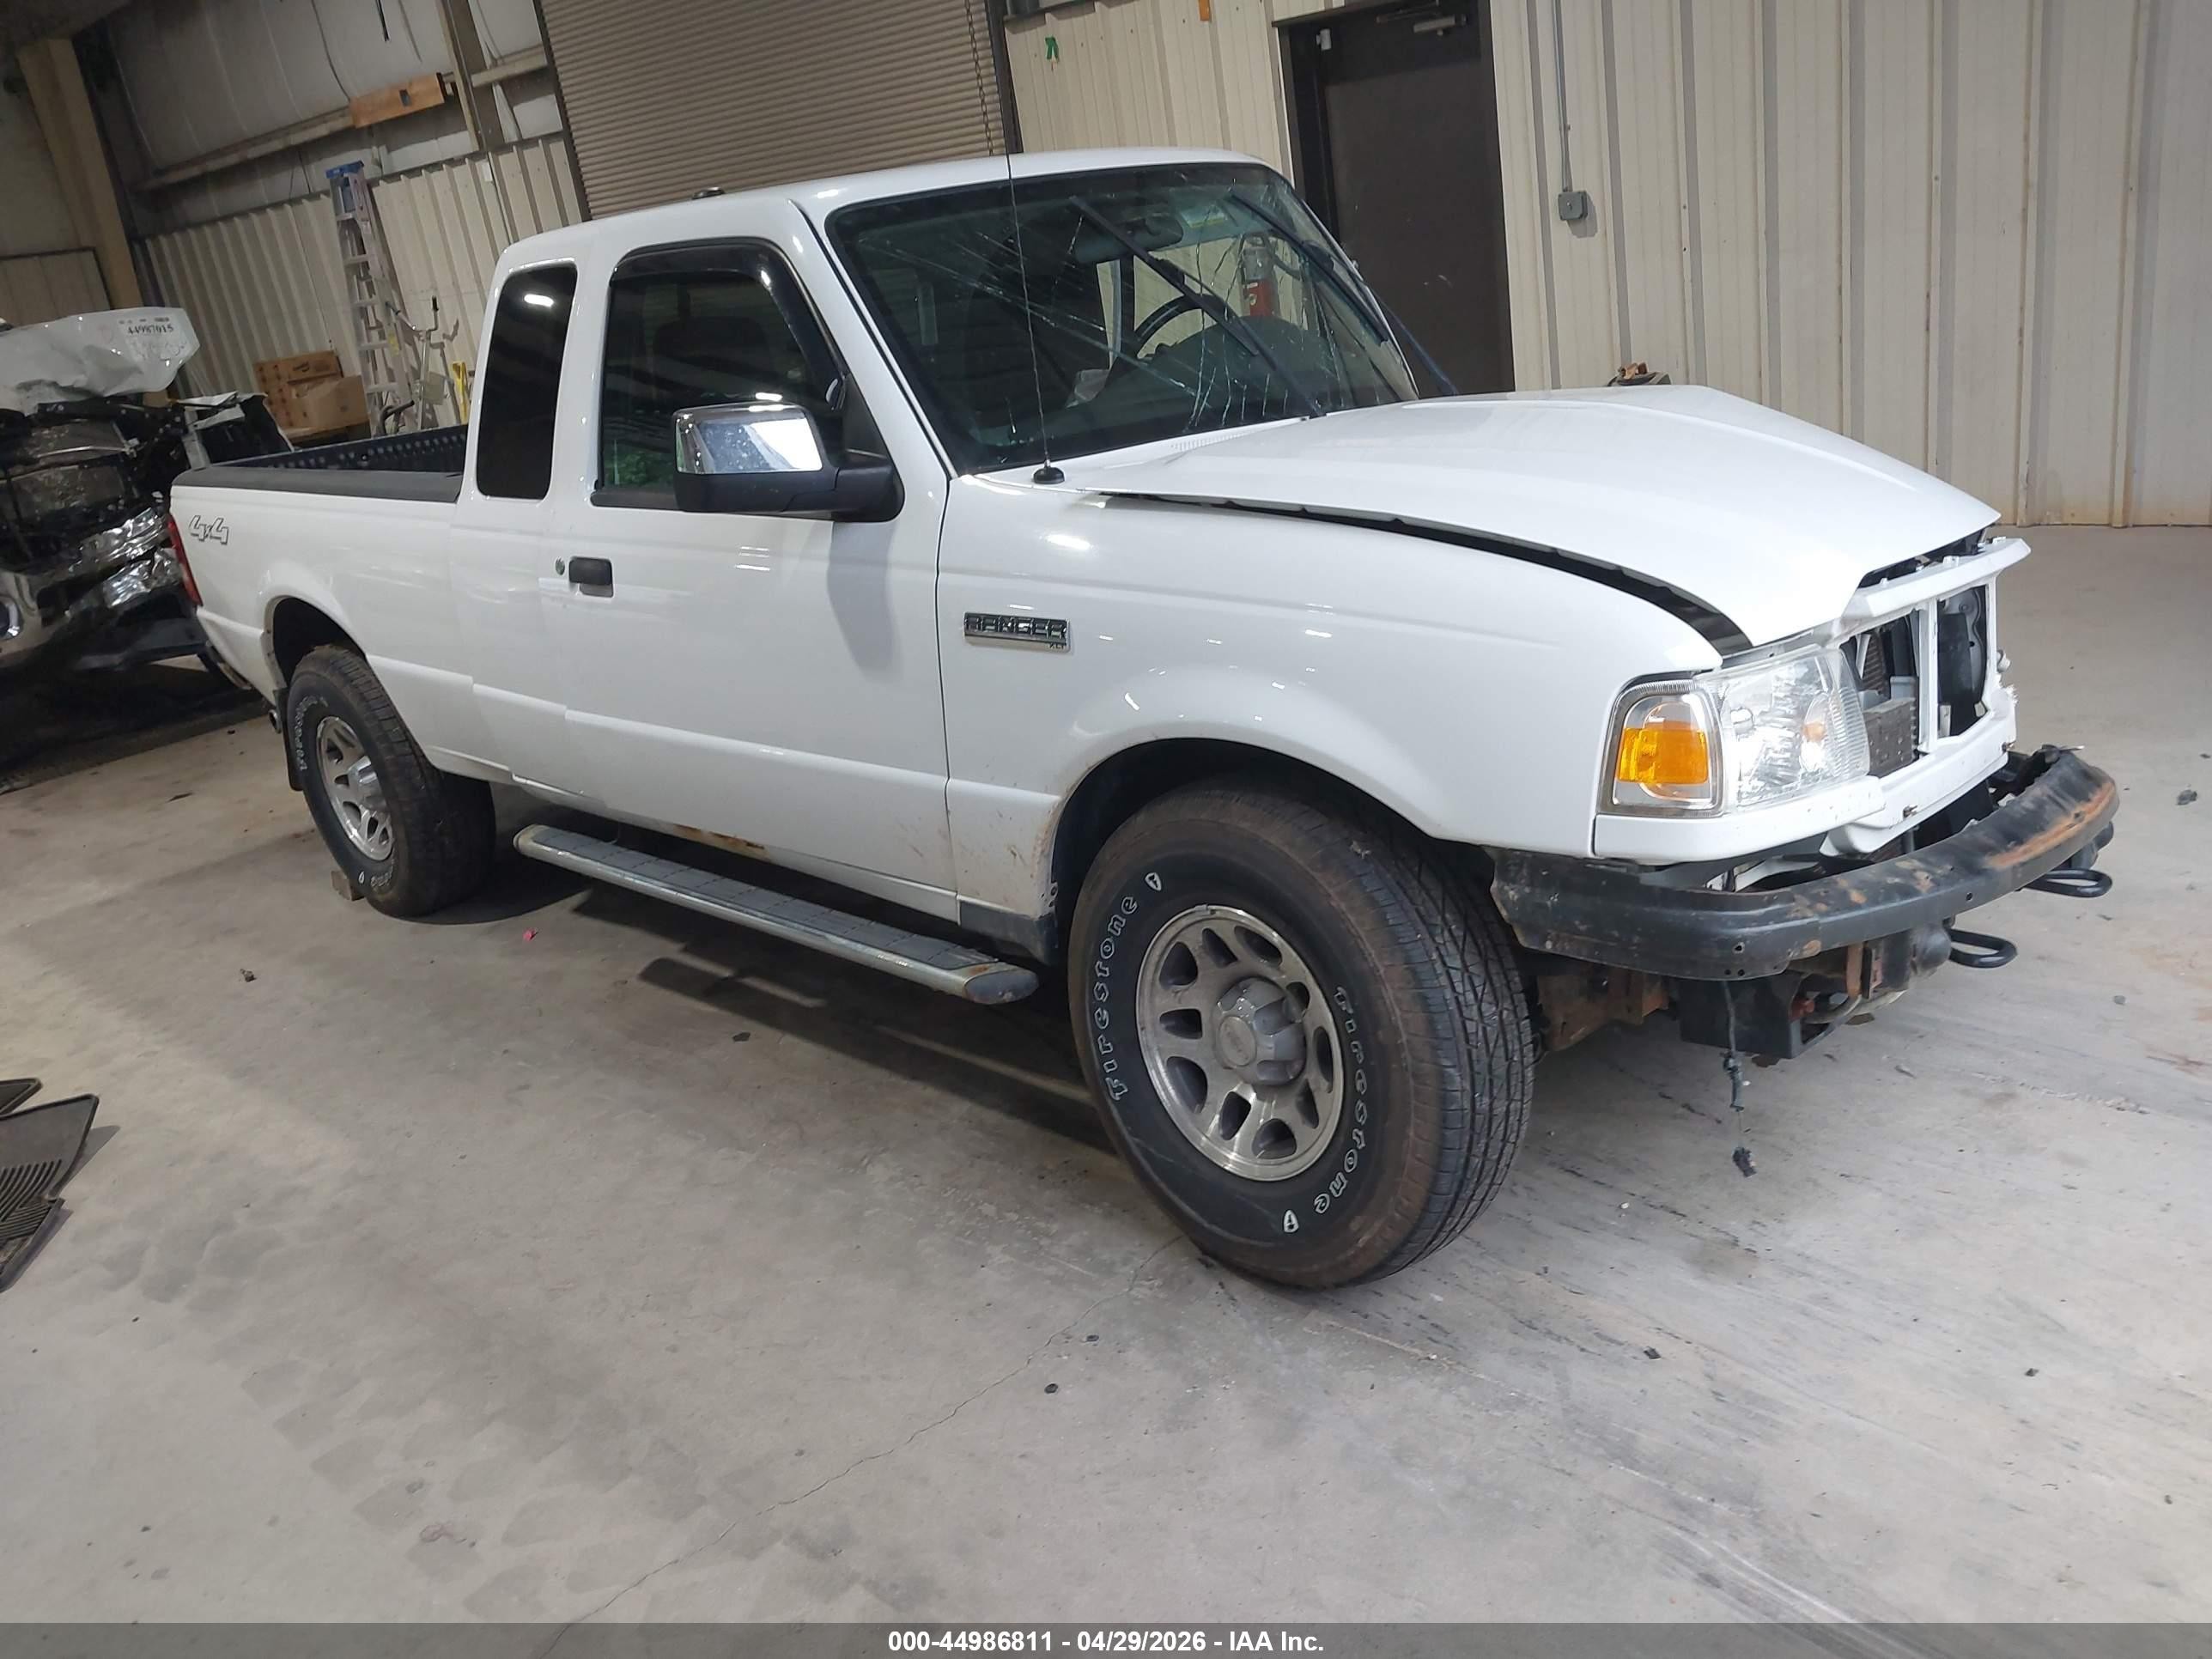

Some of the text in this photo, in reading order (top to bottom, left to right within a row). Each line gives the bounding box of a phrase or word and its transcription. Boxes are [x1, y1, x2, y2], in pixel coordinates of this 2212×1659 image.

[189, 514, 229, 545] 4x4
[963, 613, 1067, 642] RANGER
[1093, 896, 1138, 1102] Firestone
